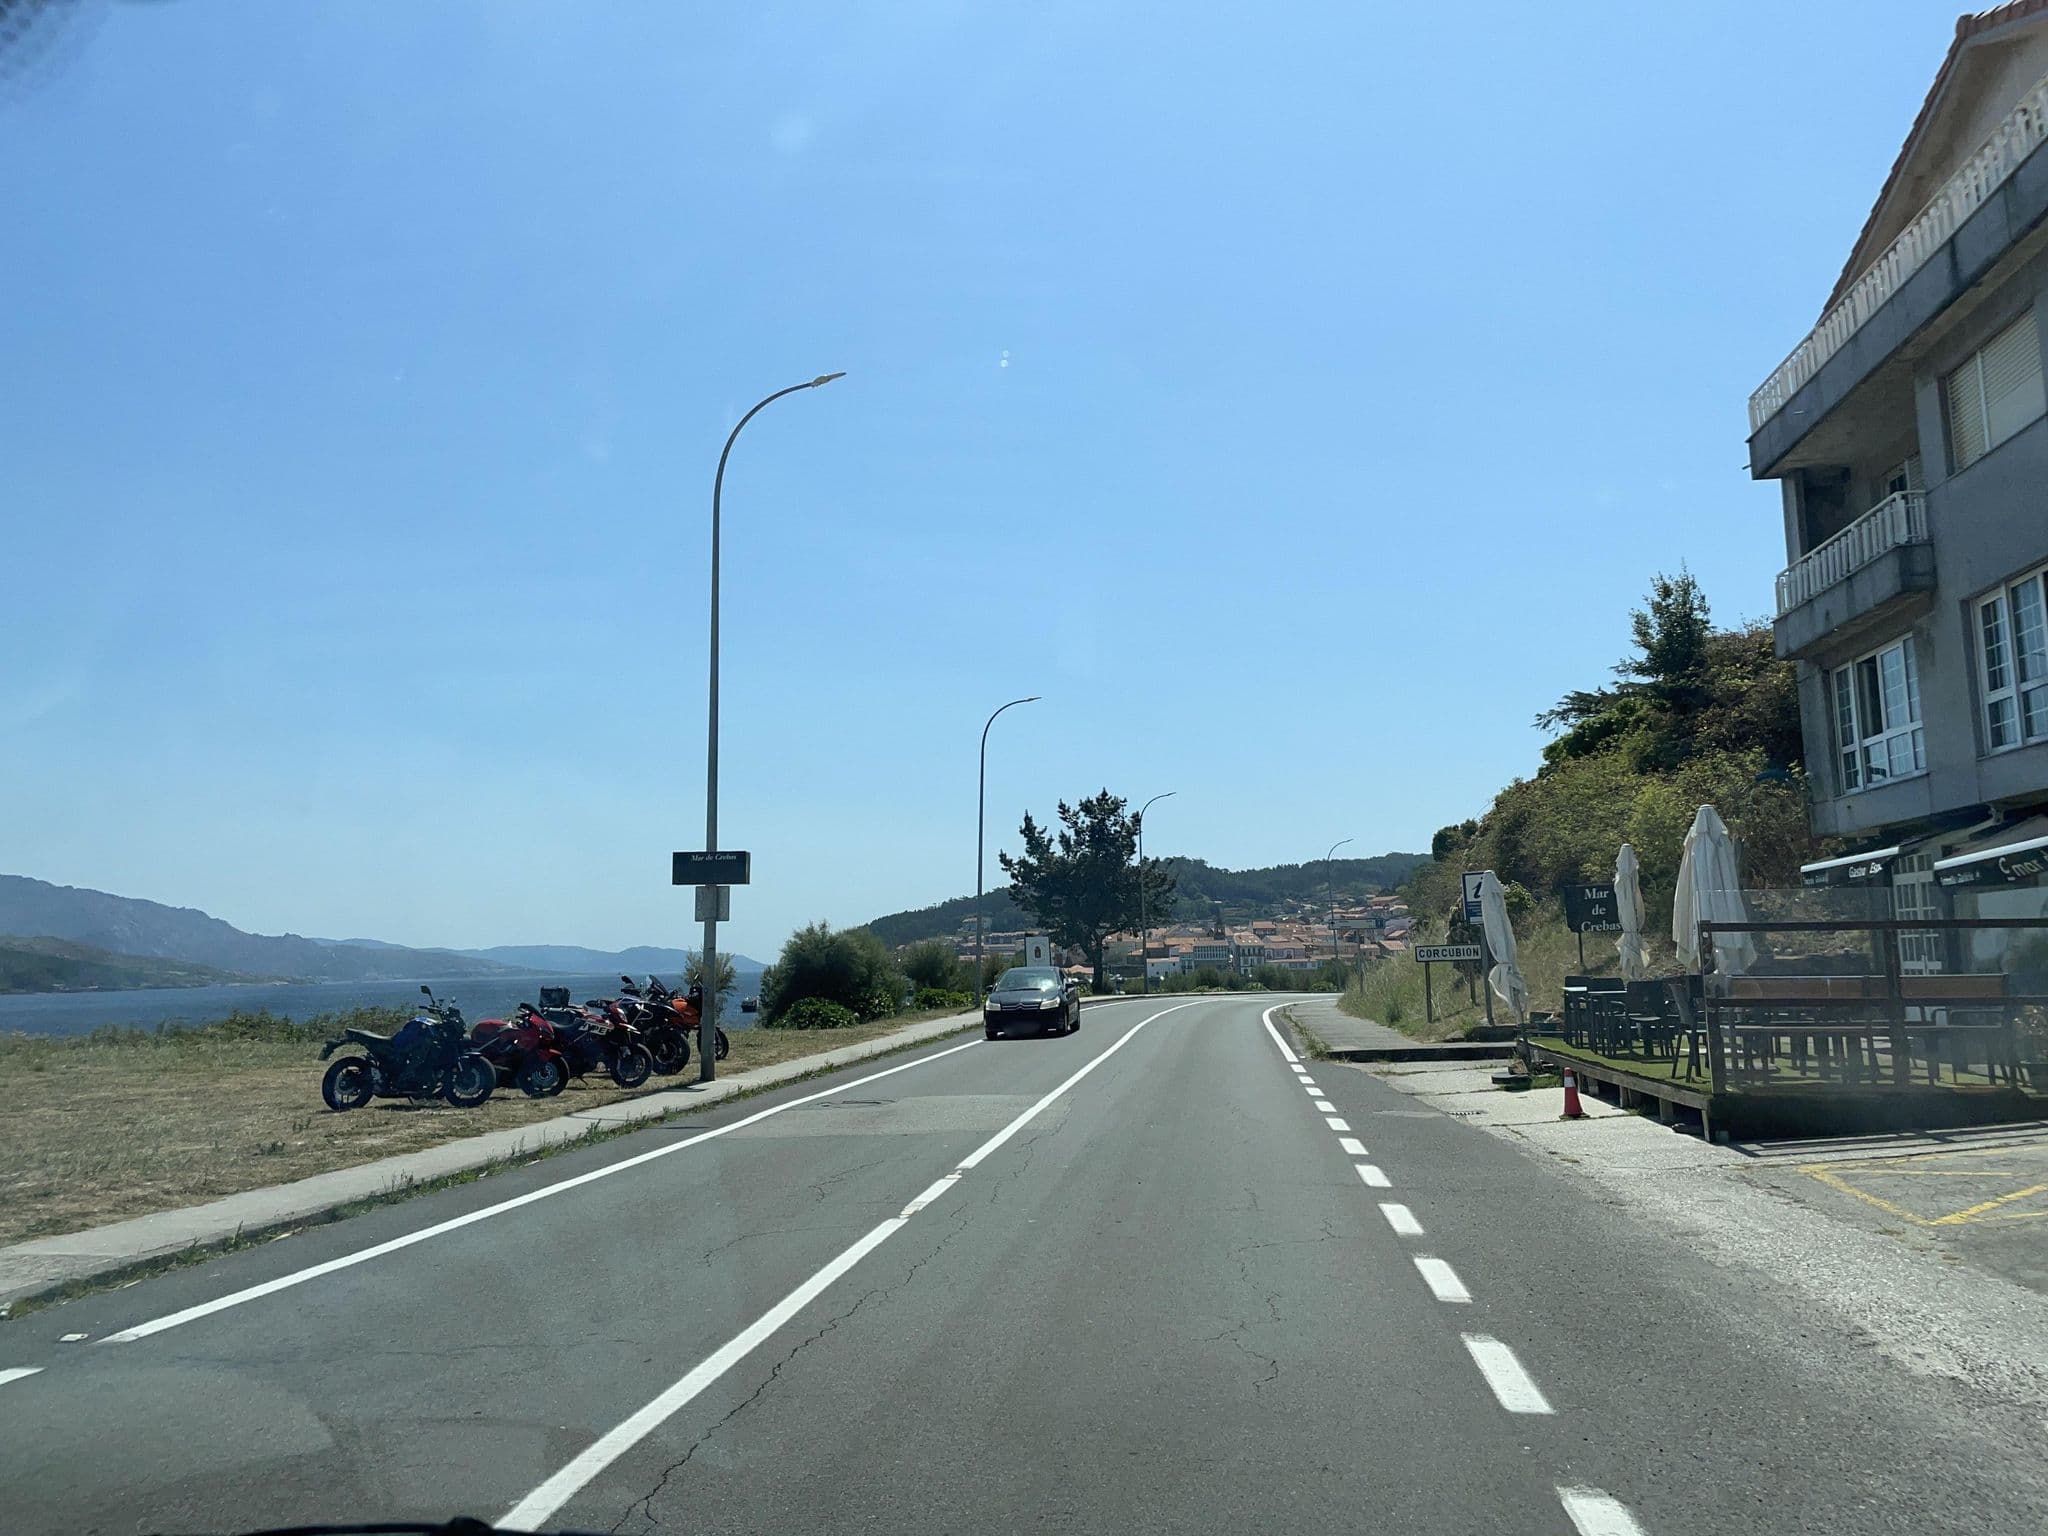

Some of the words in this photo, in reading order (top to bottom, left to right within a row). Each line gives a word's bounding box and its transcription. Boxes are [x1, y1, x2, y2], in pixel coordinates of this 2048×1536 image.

[1584, 888, 1609, 900] Mar
[1591, 905, 1607, 916] de
[1581, 920, 1622, 932] Crebas
[1418, 947, 1480, 959] CORCUBION
